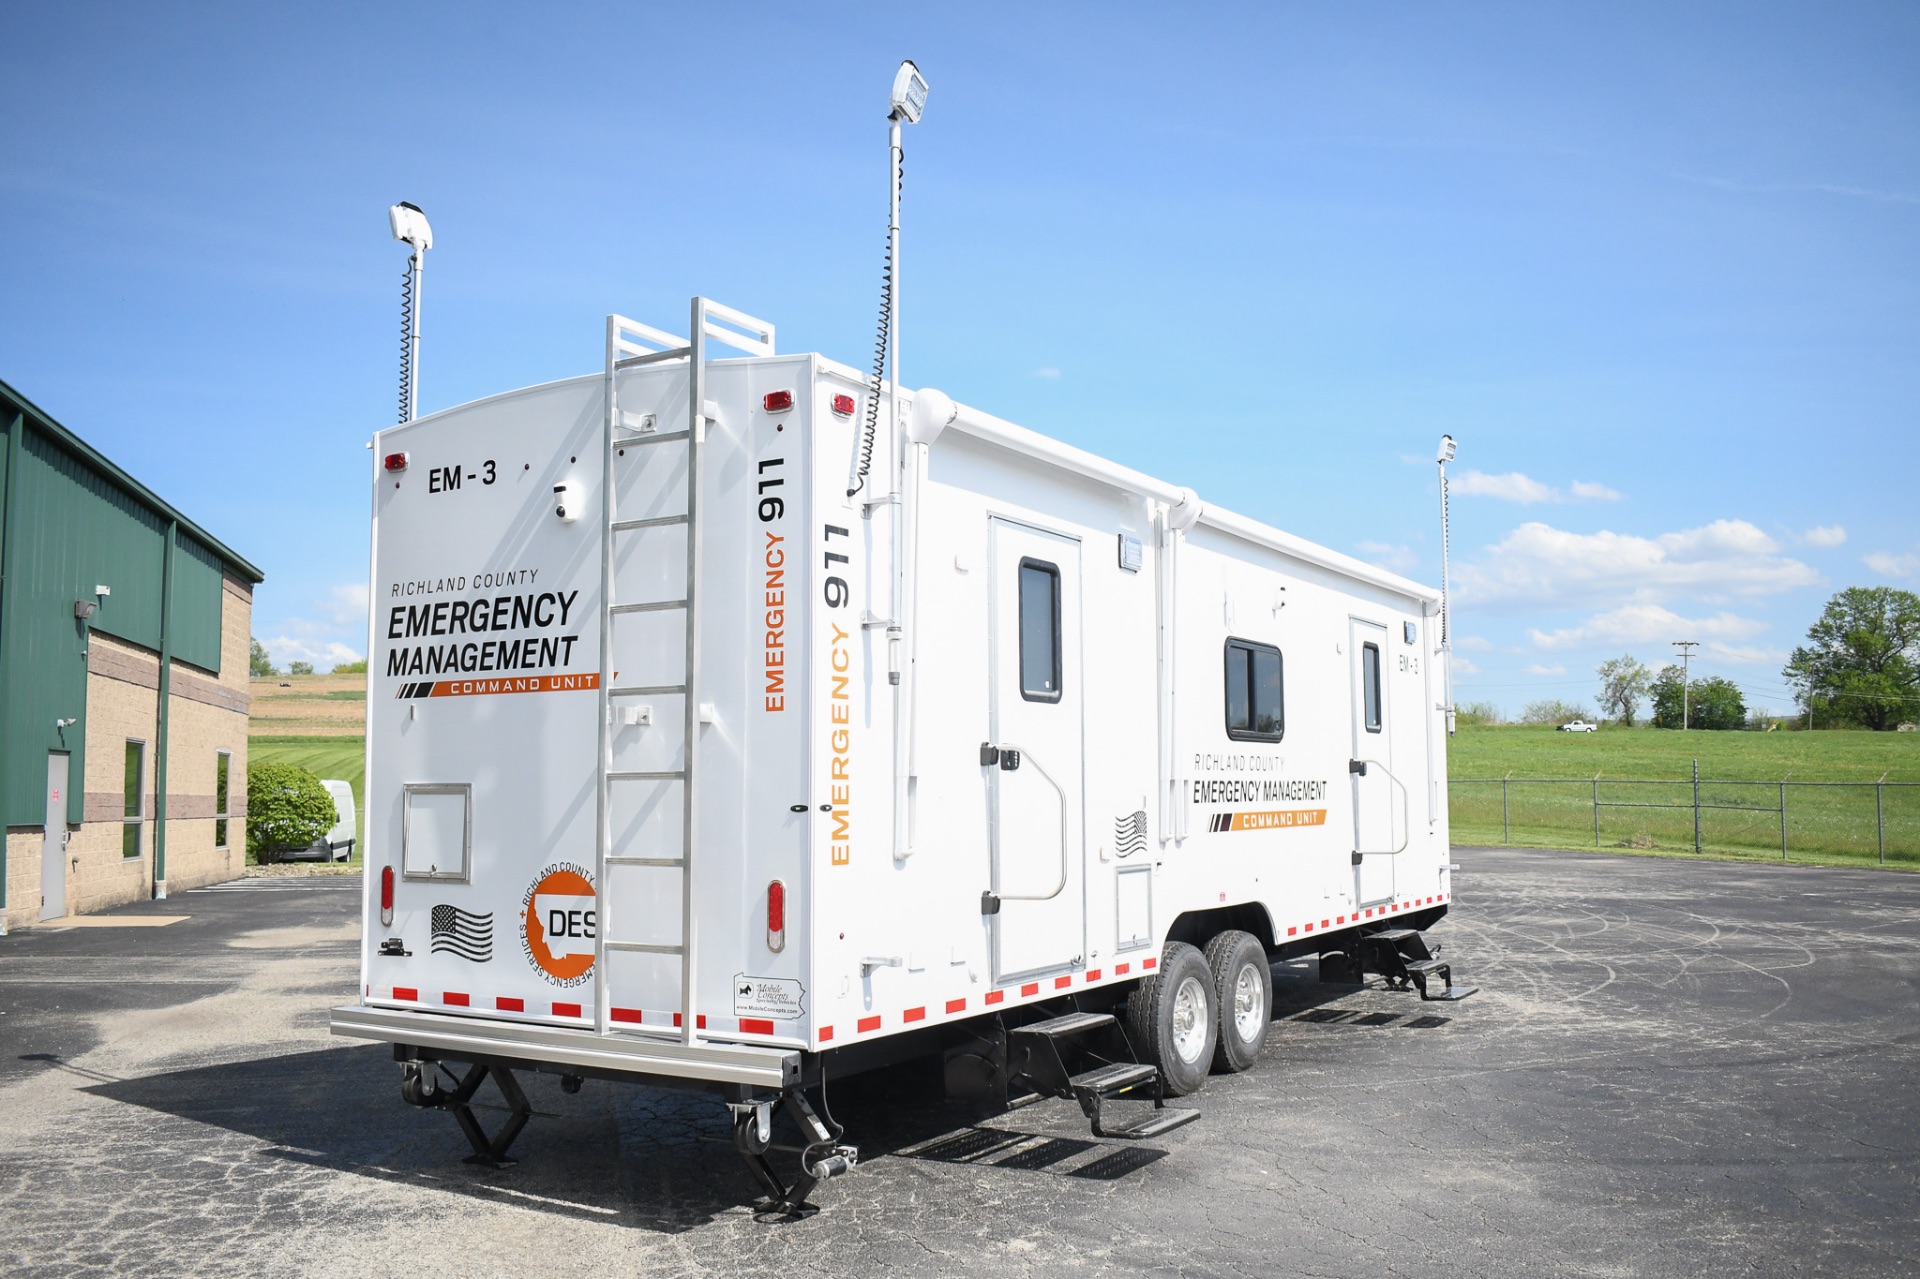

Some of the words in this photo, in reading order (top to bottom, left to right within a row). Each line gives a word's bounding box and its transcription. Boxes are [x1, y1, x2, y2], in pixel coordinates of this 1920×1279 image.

[758, 457, 785, 522] 911
[824, 523, 849, 609] 911
[391, 576, 466, 598] RICHLAND
[472, 568, 539, 589] COUNTY
[387, 590, 579, 639] EMERGENCY
[765, 530, 785, 712] EMERGENCY
[386, 635, 579, 677] MANAGEMENT
[450, 678, 541, 694] COMMAND
[551, 675, 594, 688] UNIT
[831, 621, 849, 866] EMERGENCY
[1194, 753, 1245, 771] RICHLAND
[1249, 755, 1286, 771] COUNTY
[1193, 780, 1261, 803] EMERGENCY
[1262, 780, 1328, 801] MANAGEMENT
[1242, 813, 1293, 828] COMMAND
[1296, 811, 1318, 824] UNIT
[522, 863, 558, 907] RICHLAND
[559, 861, 595, 884] COUNTY
[549, 909, 596, 938] DES
[519, 923, 547, 977] SERVICES
[757, 983, 782, 992] Mobile
[757, 991, 789, 1000] Concepts
[736, 1005, 798, 1014] www.MobileConcepts.com
